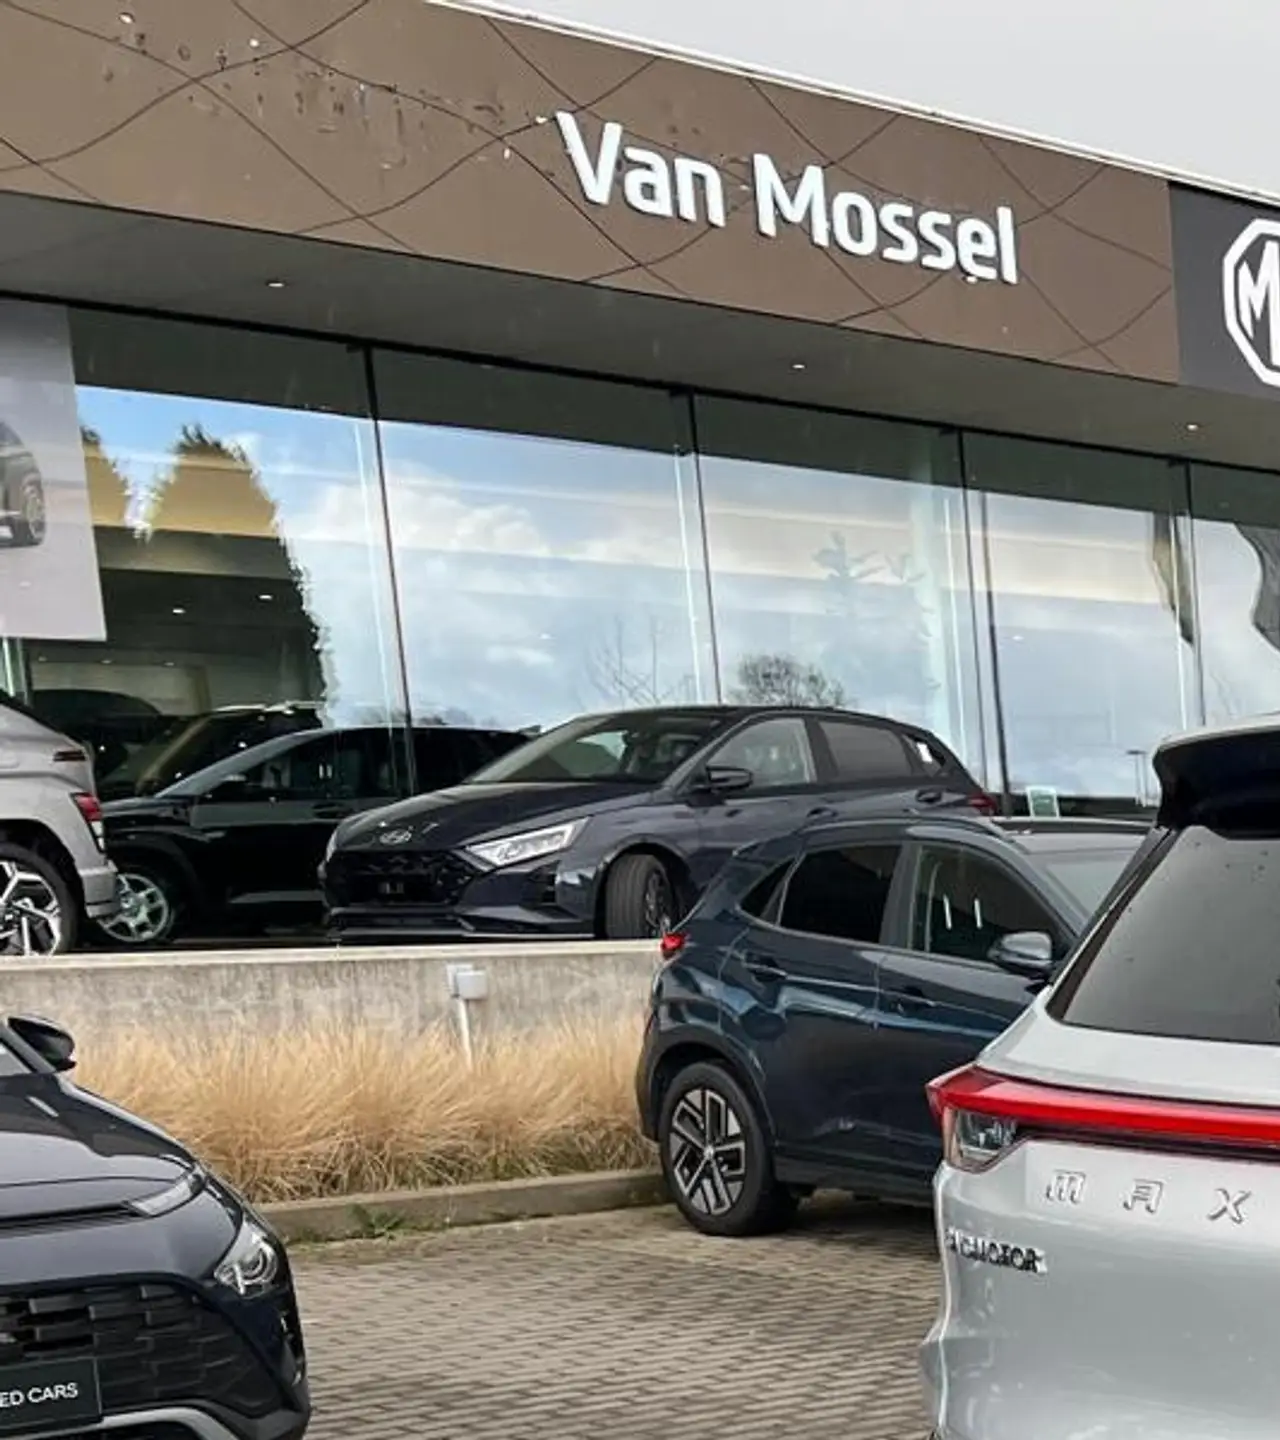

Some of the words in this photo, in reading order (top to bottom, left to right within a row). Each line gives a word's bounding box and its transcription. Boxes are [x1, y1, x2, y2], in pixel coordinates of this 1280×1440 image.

[556, 110, 725, 228] Van
[753, 152, 1019, 285] Mossel
[27, 1382, 78, 1403] CARS
